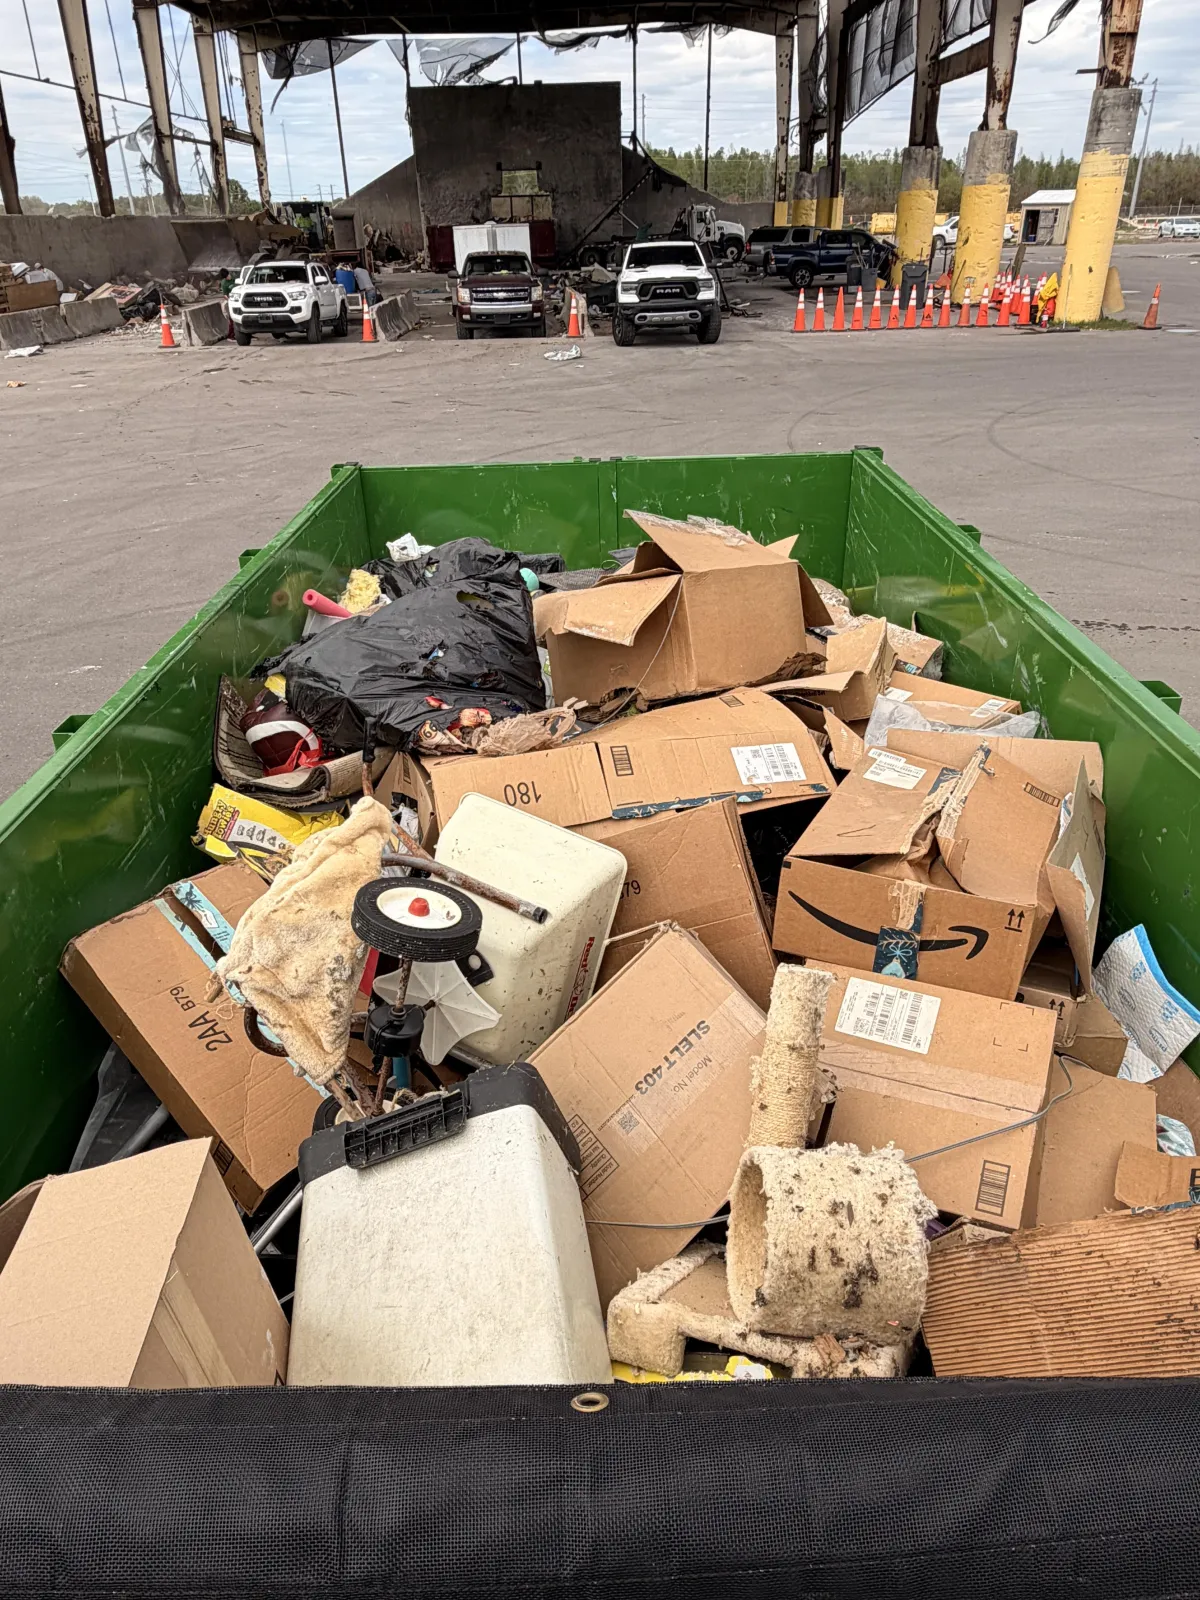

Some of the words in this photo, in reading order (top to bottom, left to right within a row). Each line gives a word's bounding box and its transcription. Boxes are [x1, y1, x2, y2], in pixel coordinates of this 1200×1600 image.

[655, 287, 681, 295] RAM
[503, 780, 542, 807] 180
[619, 879, 641, 899] 79
[169, 986, 196, 1012] B79
[187, 1010, 234, 1052] 2AA
[685, 1055, 713, 1082] Model
